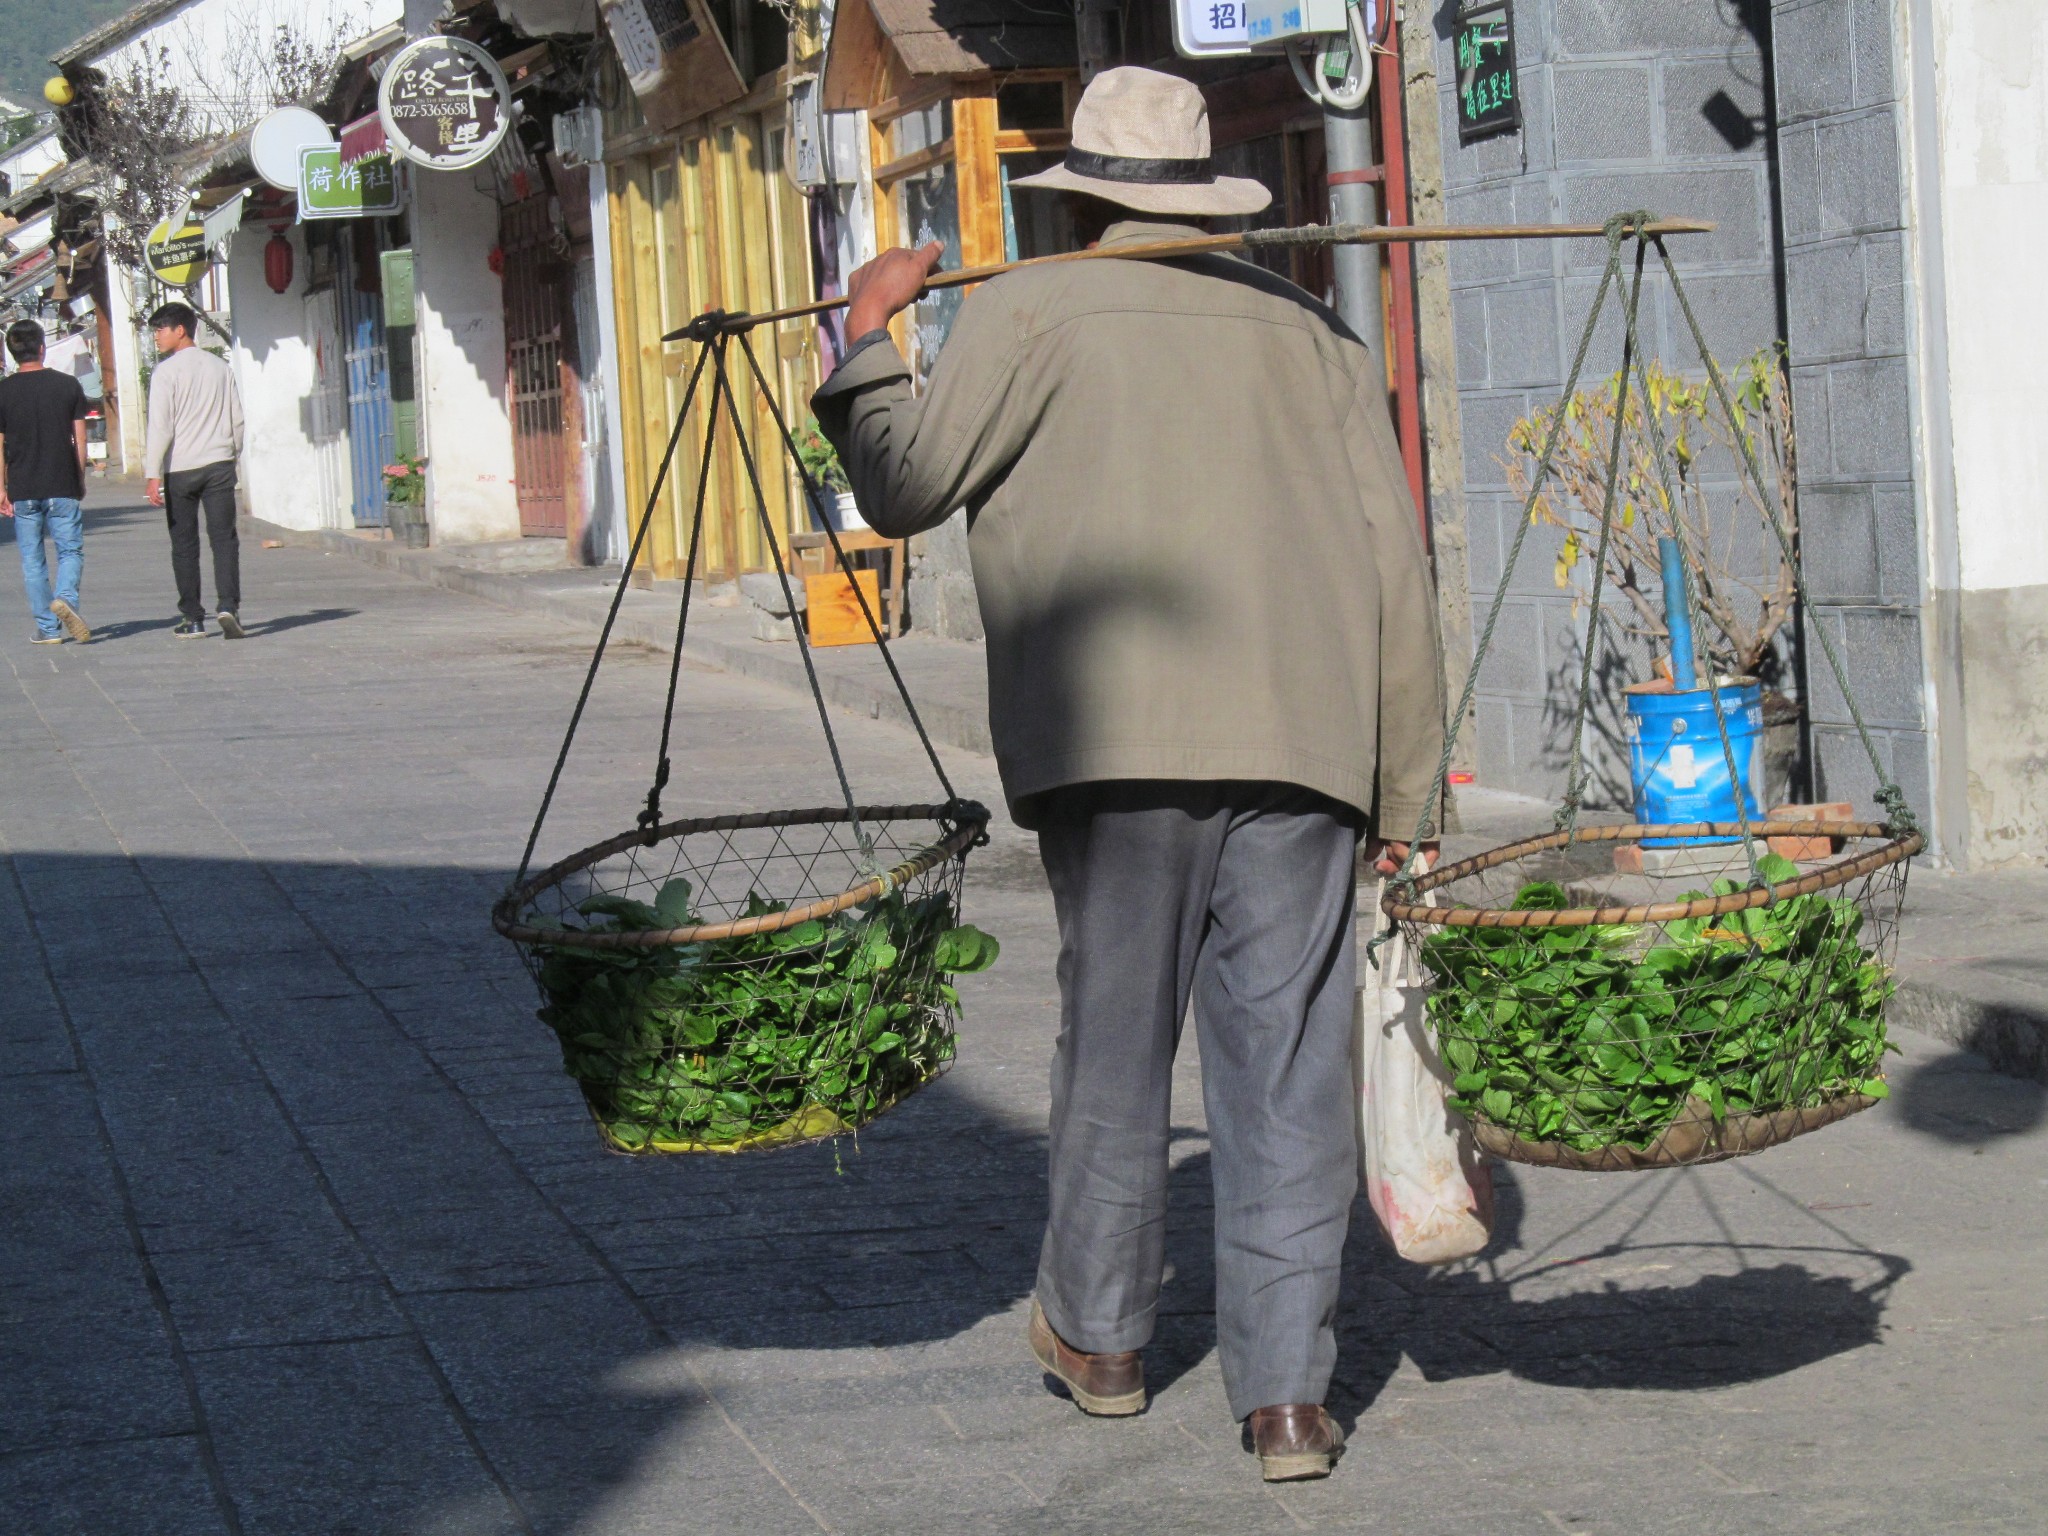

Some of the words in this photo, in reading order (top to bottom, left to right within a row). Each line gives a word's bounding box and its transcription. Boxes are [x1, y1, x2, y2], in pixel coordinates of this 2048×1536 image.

[391, 103, 468, 118] 0872-5365658
[308, 165, 392, 192] 荷作社
